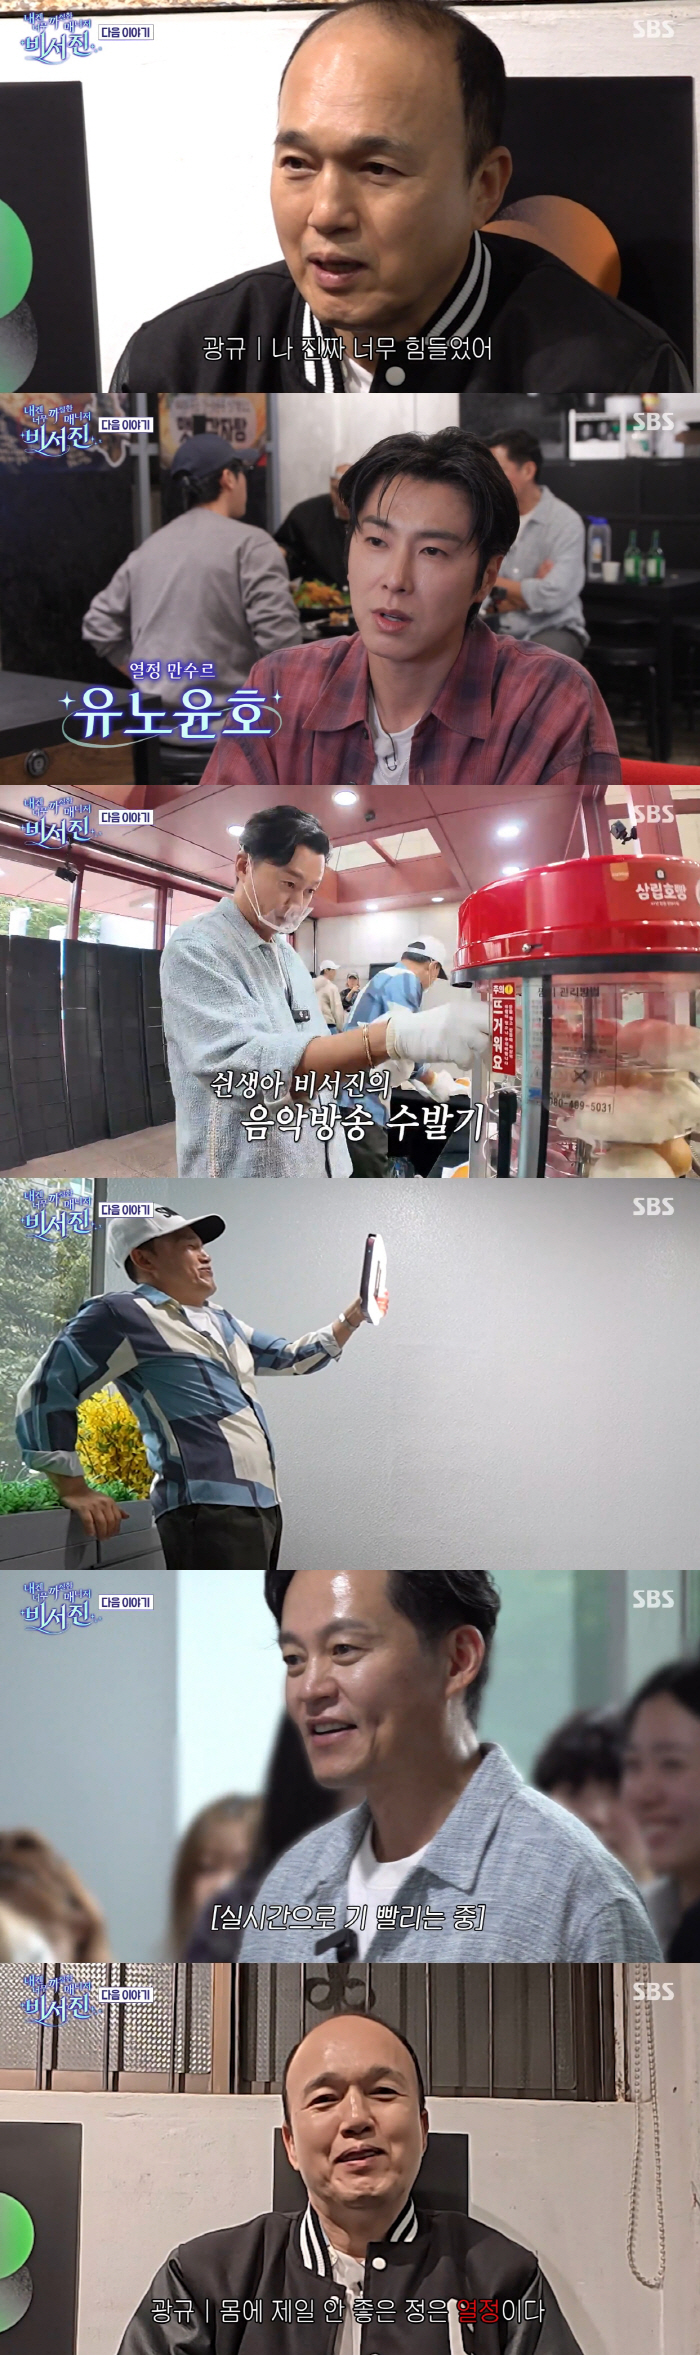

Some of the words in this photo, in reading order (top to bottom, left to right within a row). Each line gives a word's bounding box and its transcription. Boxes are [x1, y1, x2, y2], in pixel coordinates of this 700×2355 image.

[635, 882, 687, 900] 삼립호빵
[493, 985, 504, 994] 주의
[493, 1000, 503, 1070] 뜨거워요
